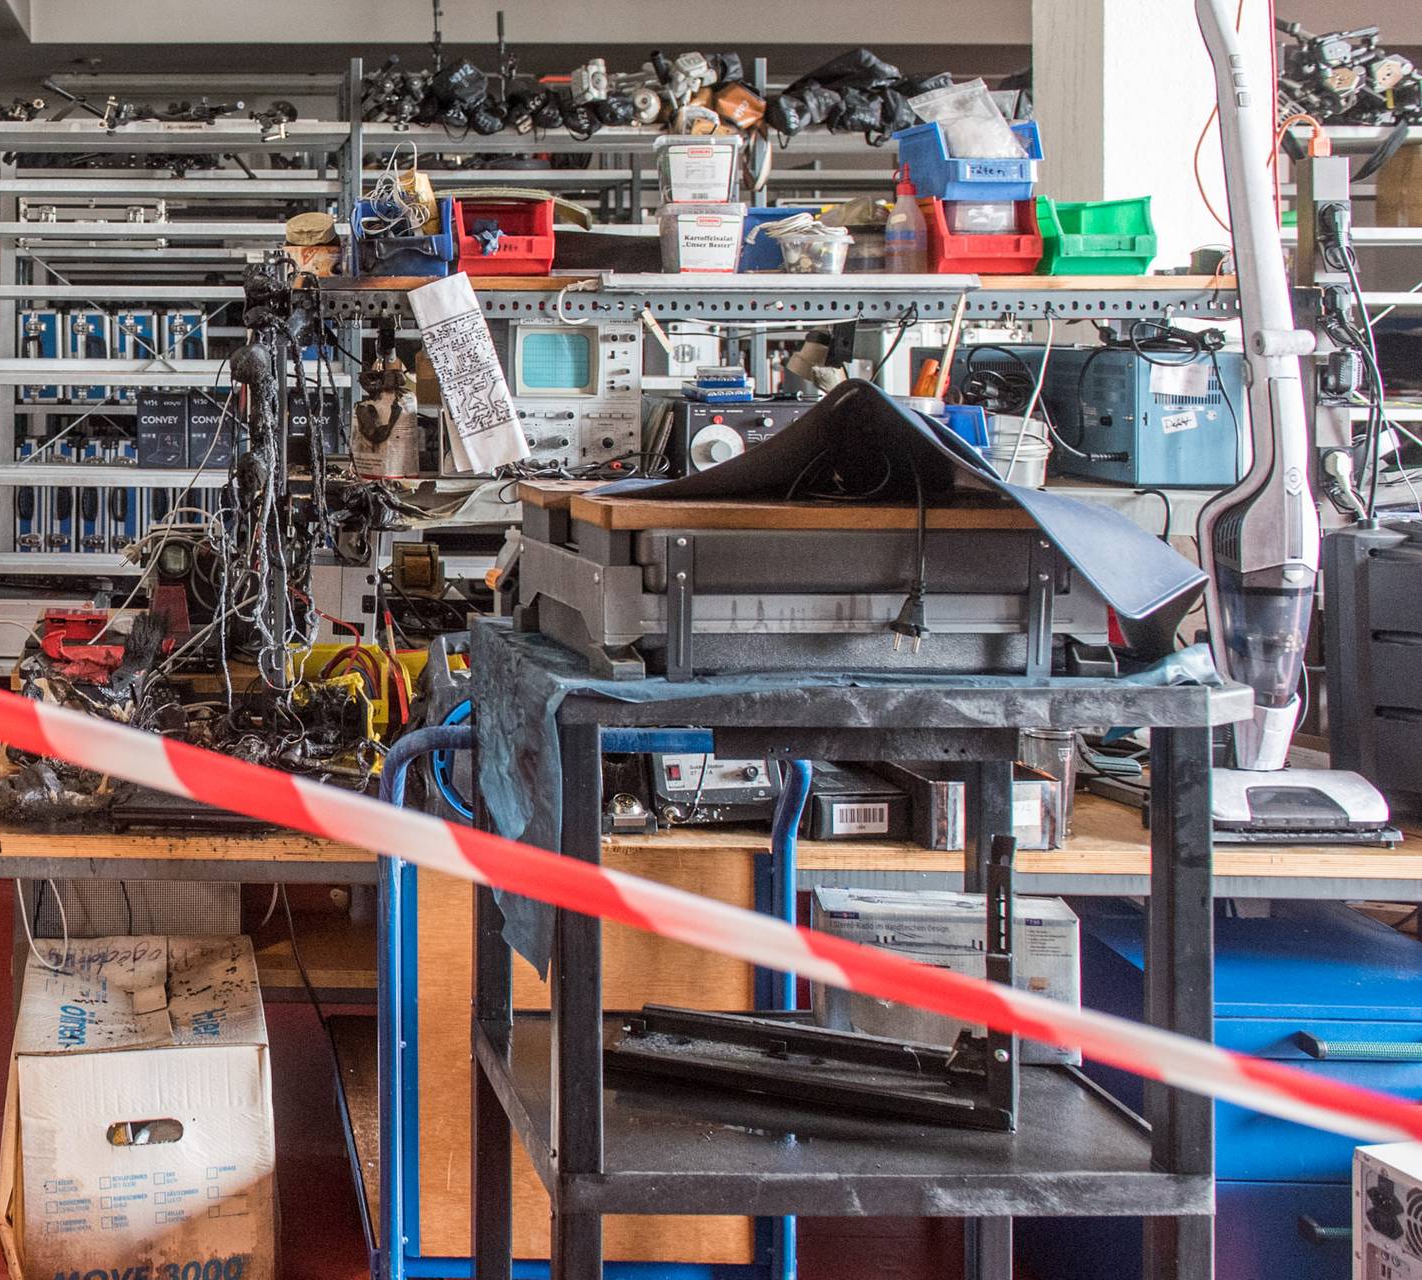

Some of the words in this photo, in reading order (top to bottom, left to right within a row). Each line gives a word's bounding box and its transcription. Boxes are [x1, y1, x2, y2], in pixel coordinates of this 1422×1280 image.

[684, 234, 734, 242] Kartoffelsalat
[140, 415, 179, 425] CONVEY
[291, 416, 331, 425] COVEY
